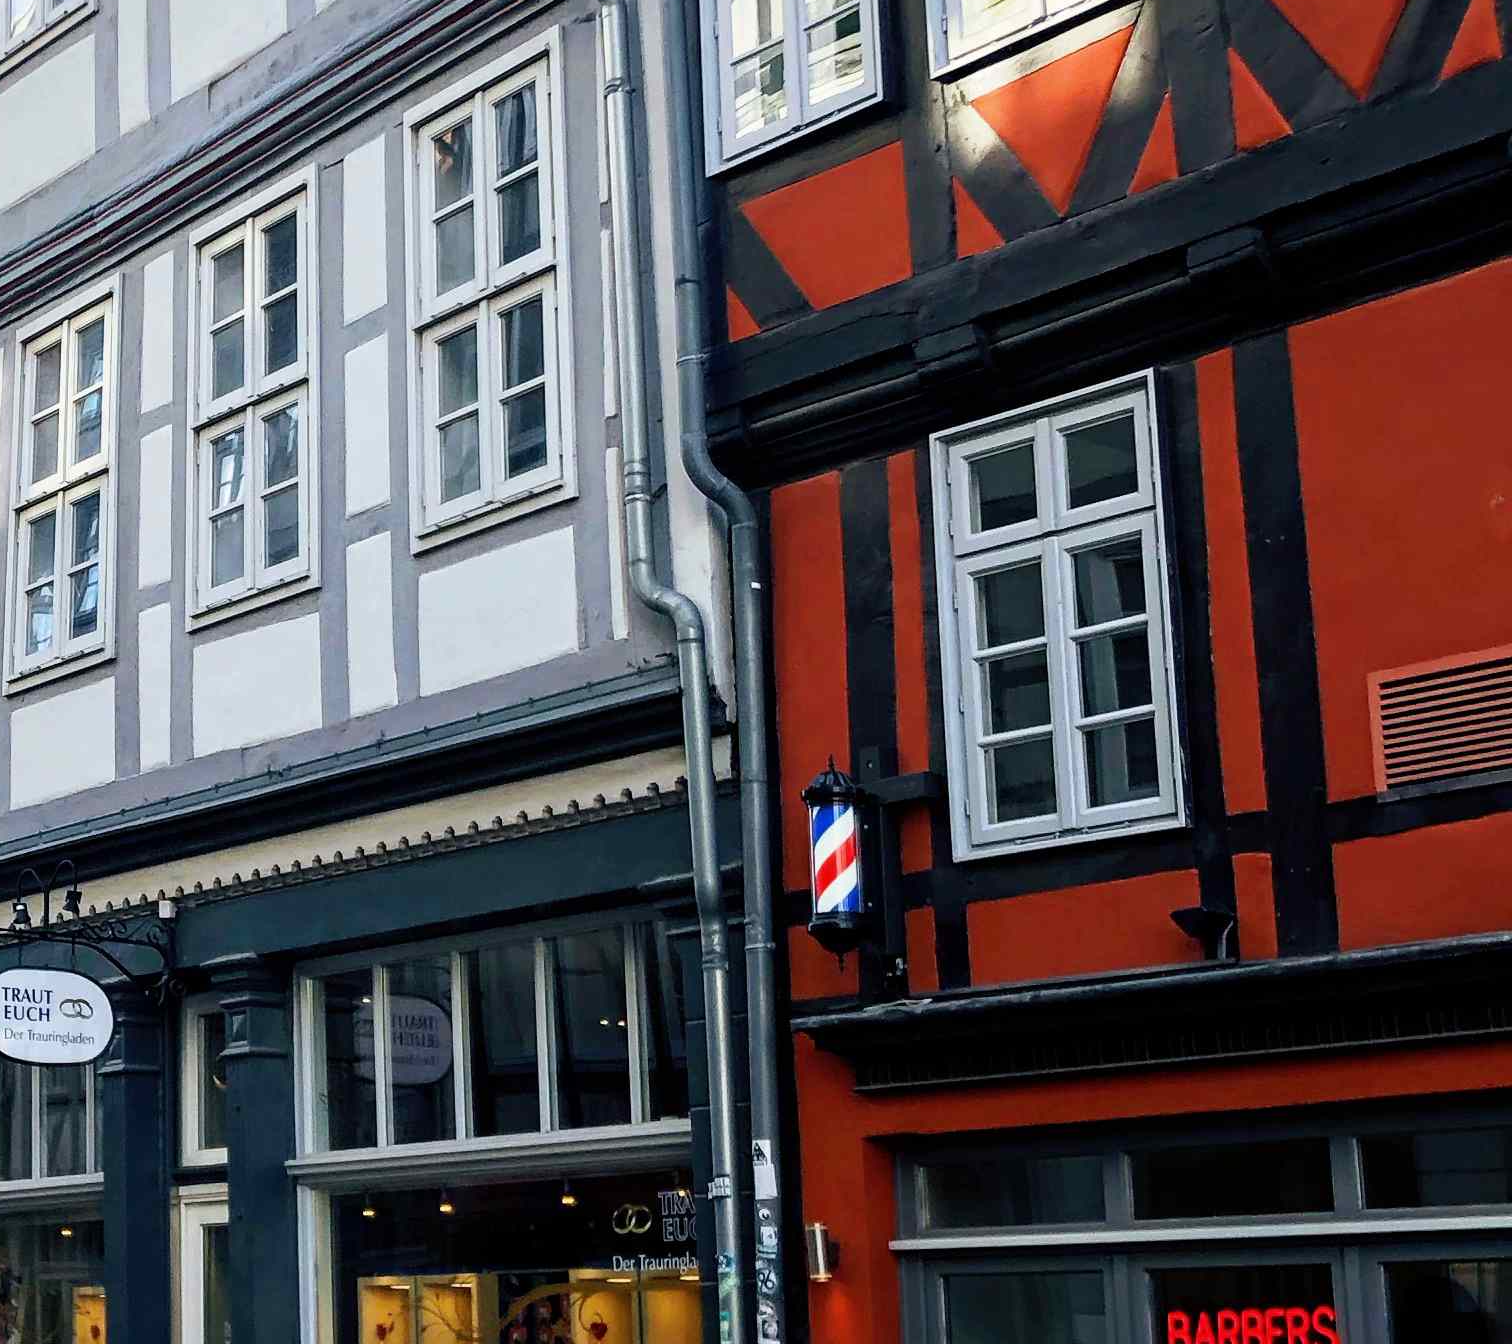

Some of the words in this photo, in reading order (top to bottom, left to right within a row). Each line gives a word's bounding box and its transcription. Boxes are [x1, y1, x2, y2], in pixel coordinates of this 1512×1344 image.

[1, 986, 53, 1004] TRAUT
[4, 1005, 50, 1022] EUCH
[4, 1027, 24, 1040] Der
[27, 1029, 95, 1046] Trauringladen
[657, 1189, 697, 1216] TRA
[612, 1255, 635, 1272] Der
[638, 1251, 697, 1275] Trauringla
